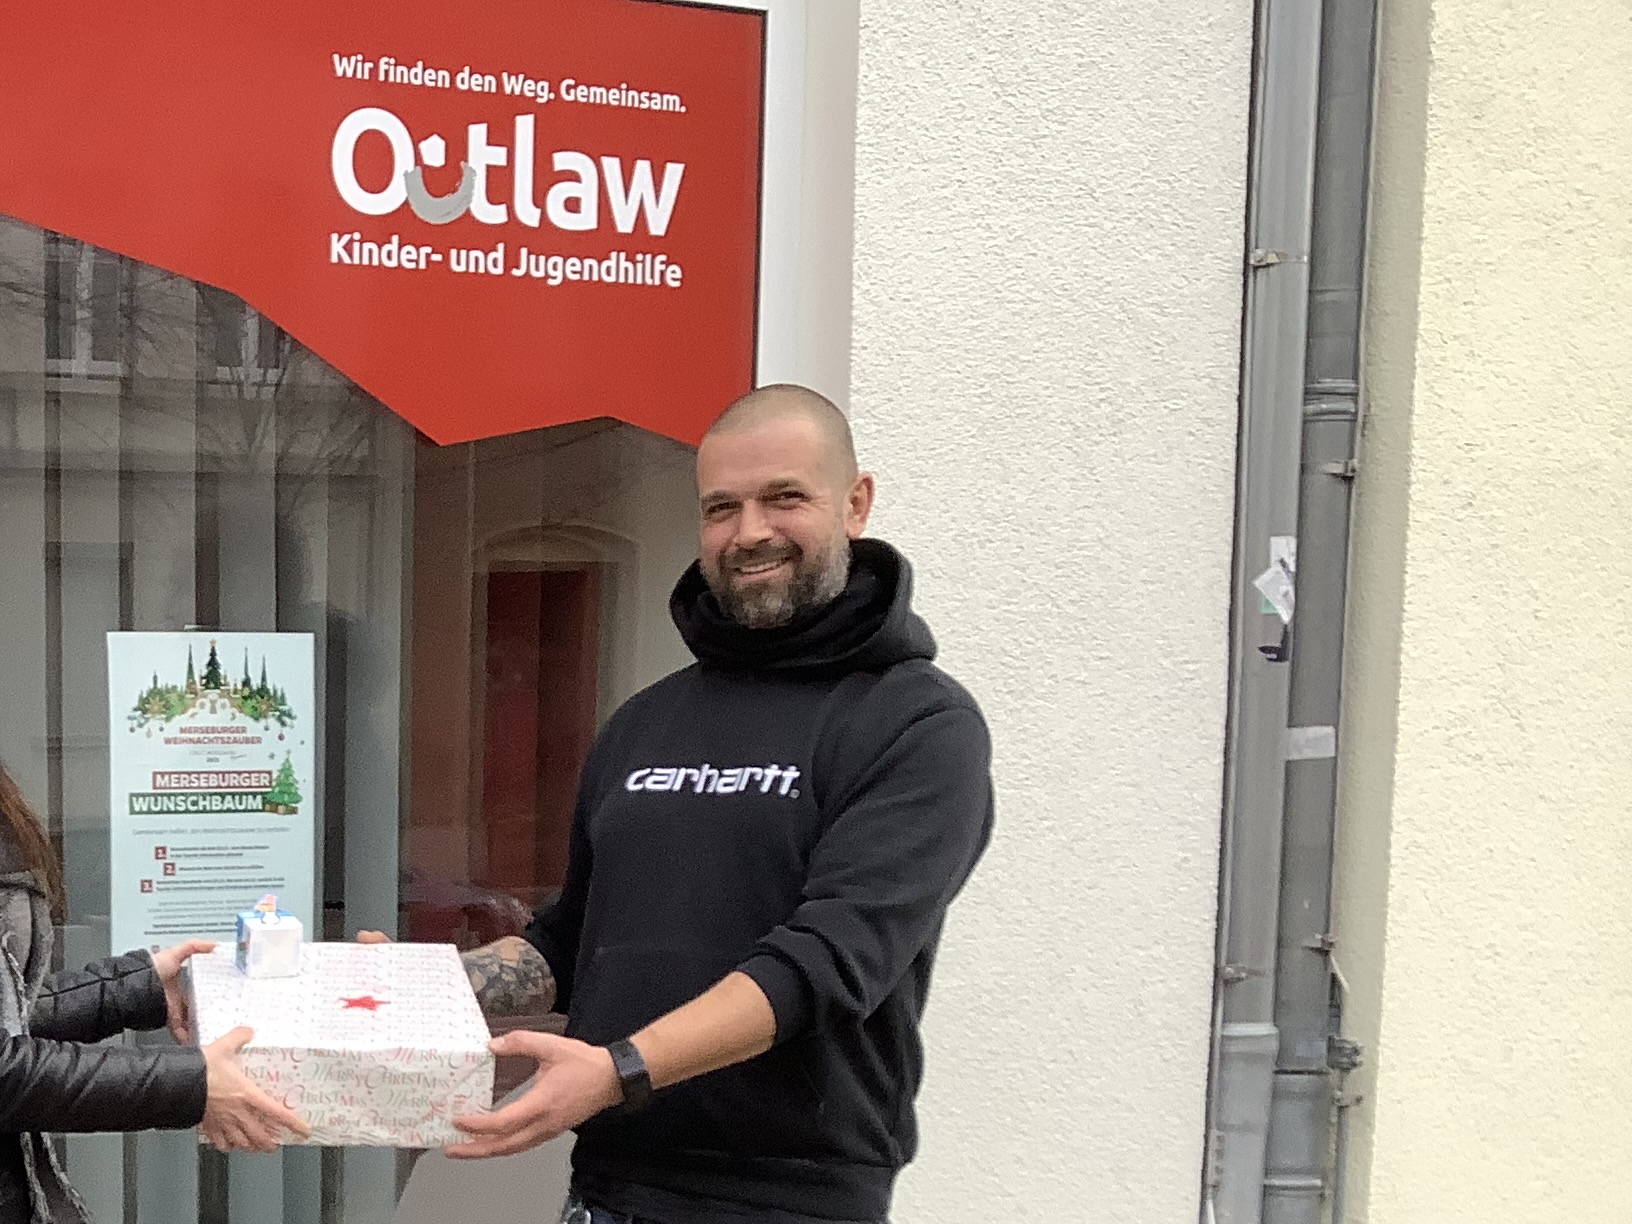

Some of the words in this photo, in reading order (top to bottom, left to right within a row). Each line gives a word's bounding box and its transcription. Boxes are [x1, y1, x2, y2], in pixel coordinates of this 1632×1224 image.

[332, 53, 374, 80] Wir
[379, 57, 451, 88] finden
[456, 65, 497, 93] den
[501, 72, 555, 104] Weg.
[560, 78, 687, 114] Gemeinsam.
[331, 106, 686, 237] Outlaw
[330, 232, 443, 271] Kinder-
[450, 243, 505, 275] und
[511, 247, 682, 288] Jugendhilfe
[179, 726, 248, 735] MERSEBURGER
[163, 736, 263, 745] WEIHNACHTSZAUBER
[155, 773, 270, 788] MERSEBURGER
[132, 794, 264, 813] WUNSCHBAUM
